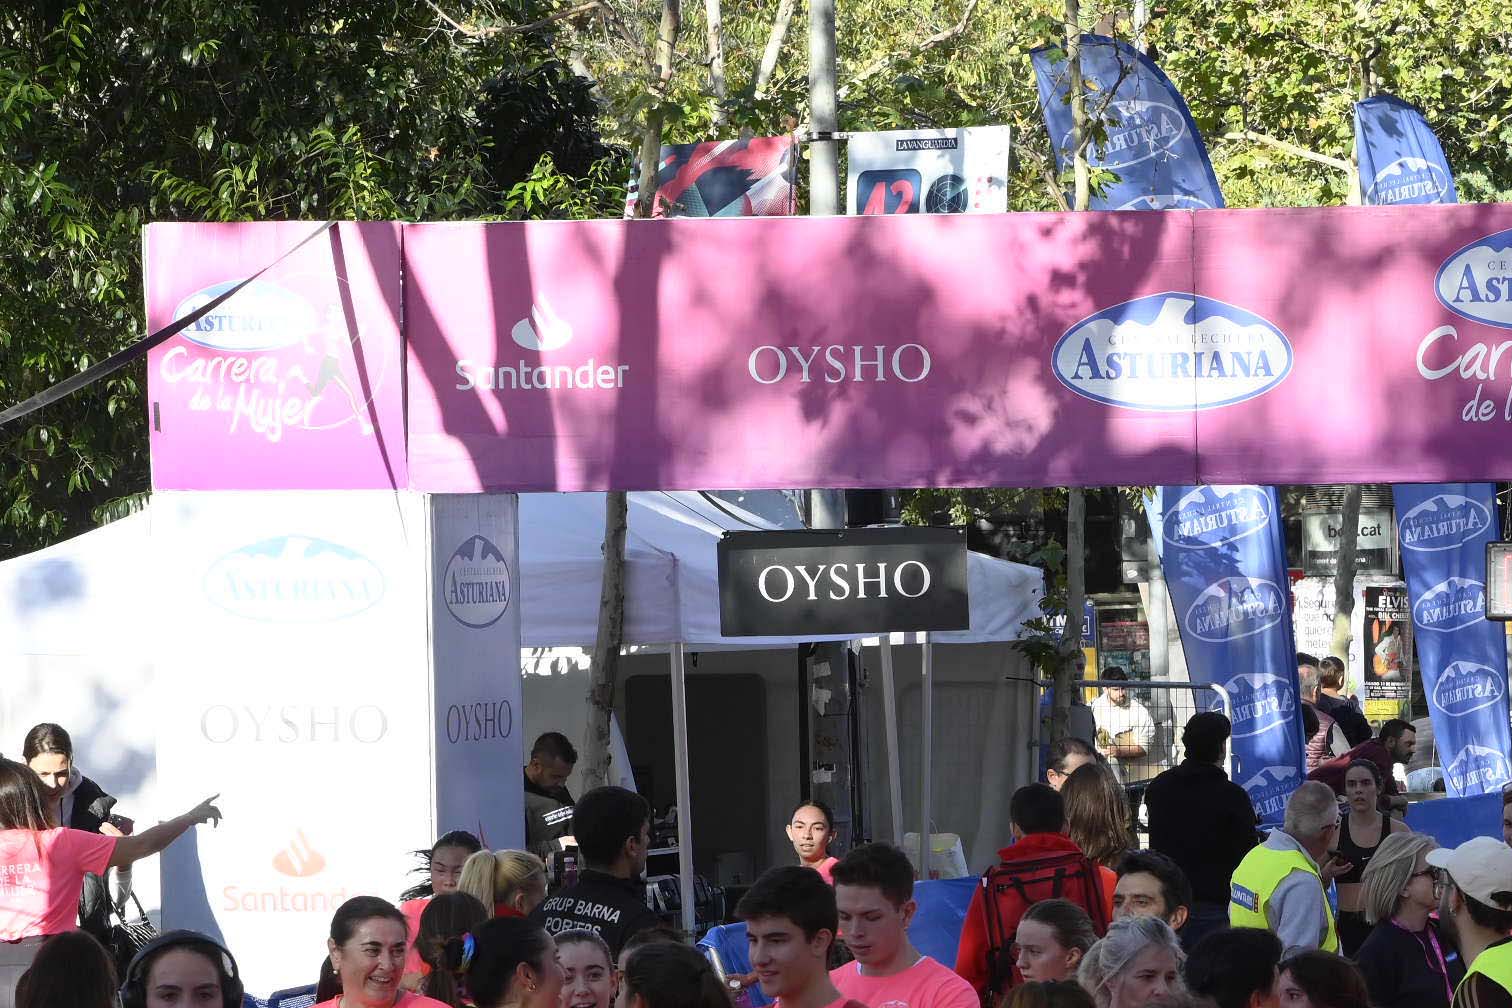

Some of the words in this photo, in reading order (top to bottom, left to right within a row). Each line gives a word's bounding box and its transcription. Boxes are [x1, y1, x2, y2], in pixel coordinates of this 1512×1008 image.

[748, 343, 932, 385] OYSHO
[1070, 326, 1275, 370] ASTURIANA
[456, 359, 630, 391] Santander
[1462, 383, 1497, 422] de
[450, 570, 507, 605] ASTURIANA
[758, 560, 931, 603] OYSHO
[200, 703, 388, 744] OYSHO
[447, 699, 512, 744] OYSHO
[544, 897, 572, 912] GRUP
[575, 899, 621, 923] BARNA
